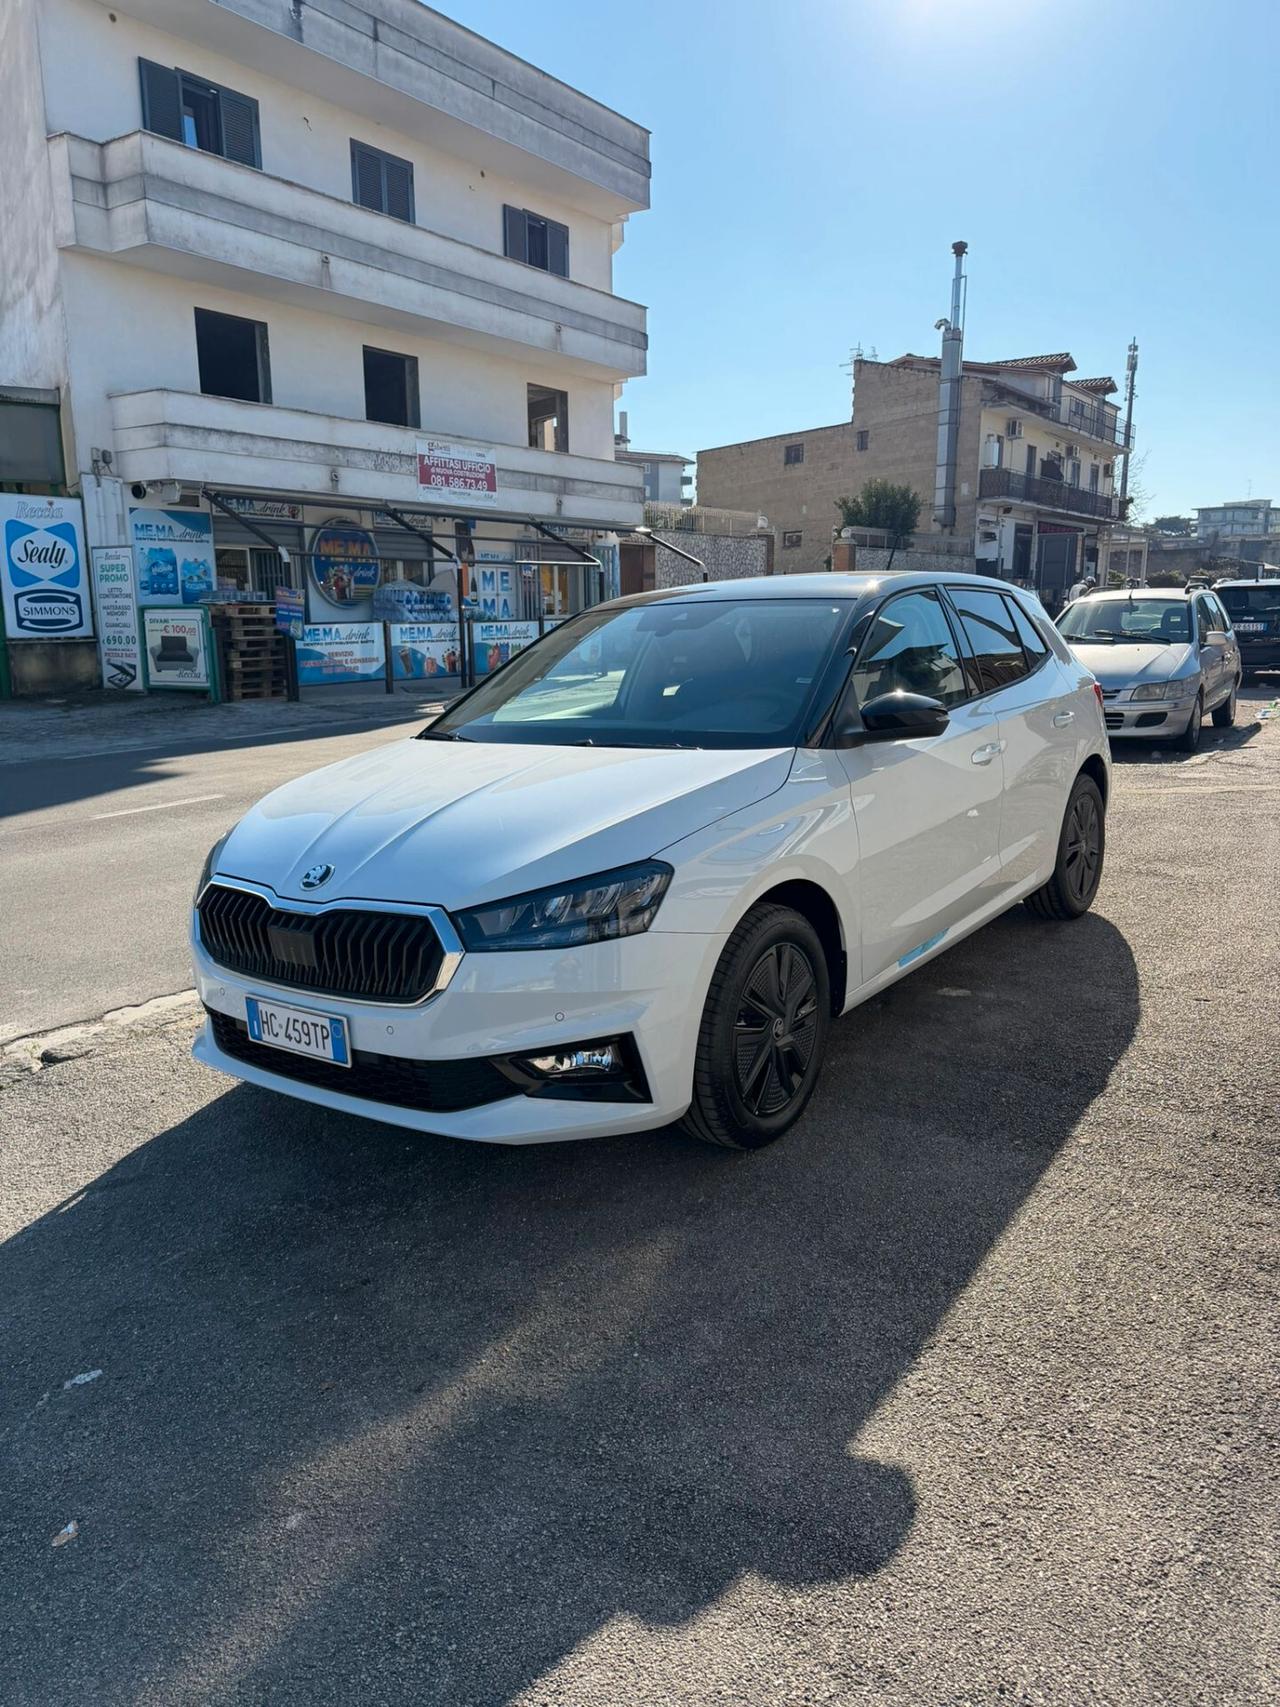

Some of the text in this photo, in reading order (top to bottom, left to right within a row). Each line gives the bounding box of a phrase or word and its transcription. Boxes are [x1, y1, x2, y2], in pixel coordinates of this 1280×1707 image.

[423, 456, 461, 470] AFFITTASI
[462, 461, 491, 473] UFFICIO
[17, 539, 66, 568] Sealy
[100, 563, 127, 572] SUPER
[99, 573, 129, 582] PROMO
[23, 606, 76, 616] SIMMONS
